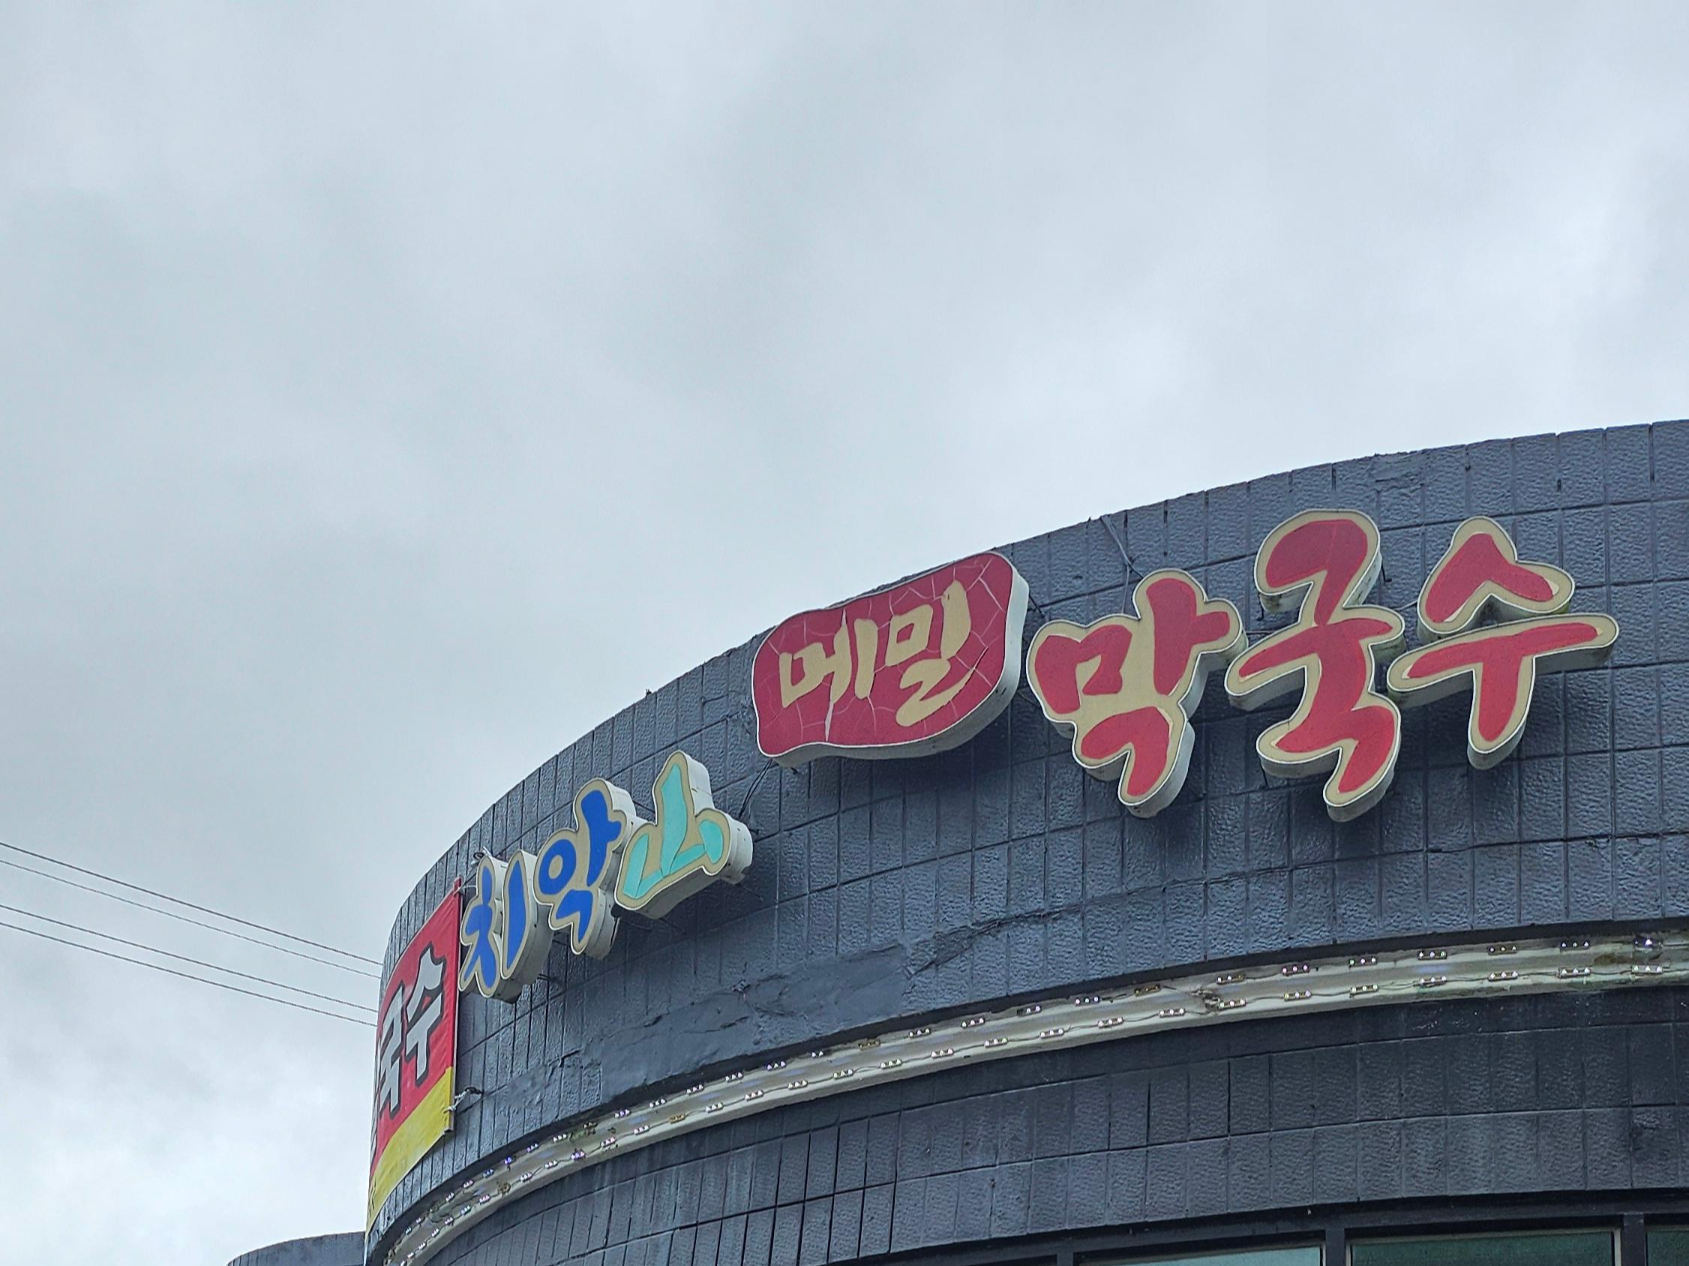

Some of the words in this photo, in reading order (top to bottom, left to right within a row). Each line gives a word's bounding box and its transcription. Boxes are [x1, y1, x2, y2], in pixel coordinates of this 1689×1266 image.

[458, 750, 732, 998] 치악산
[778, 579, 974, 727] 메밀
[1027, 509, 1620, 806] 막국수
[374, 944, 444, 1130] 국수
